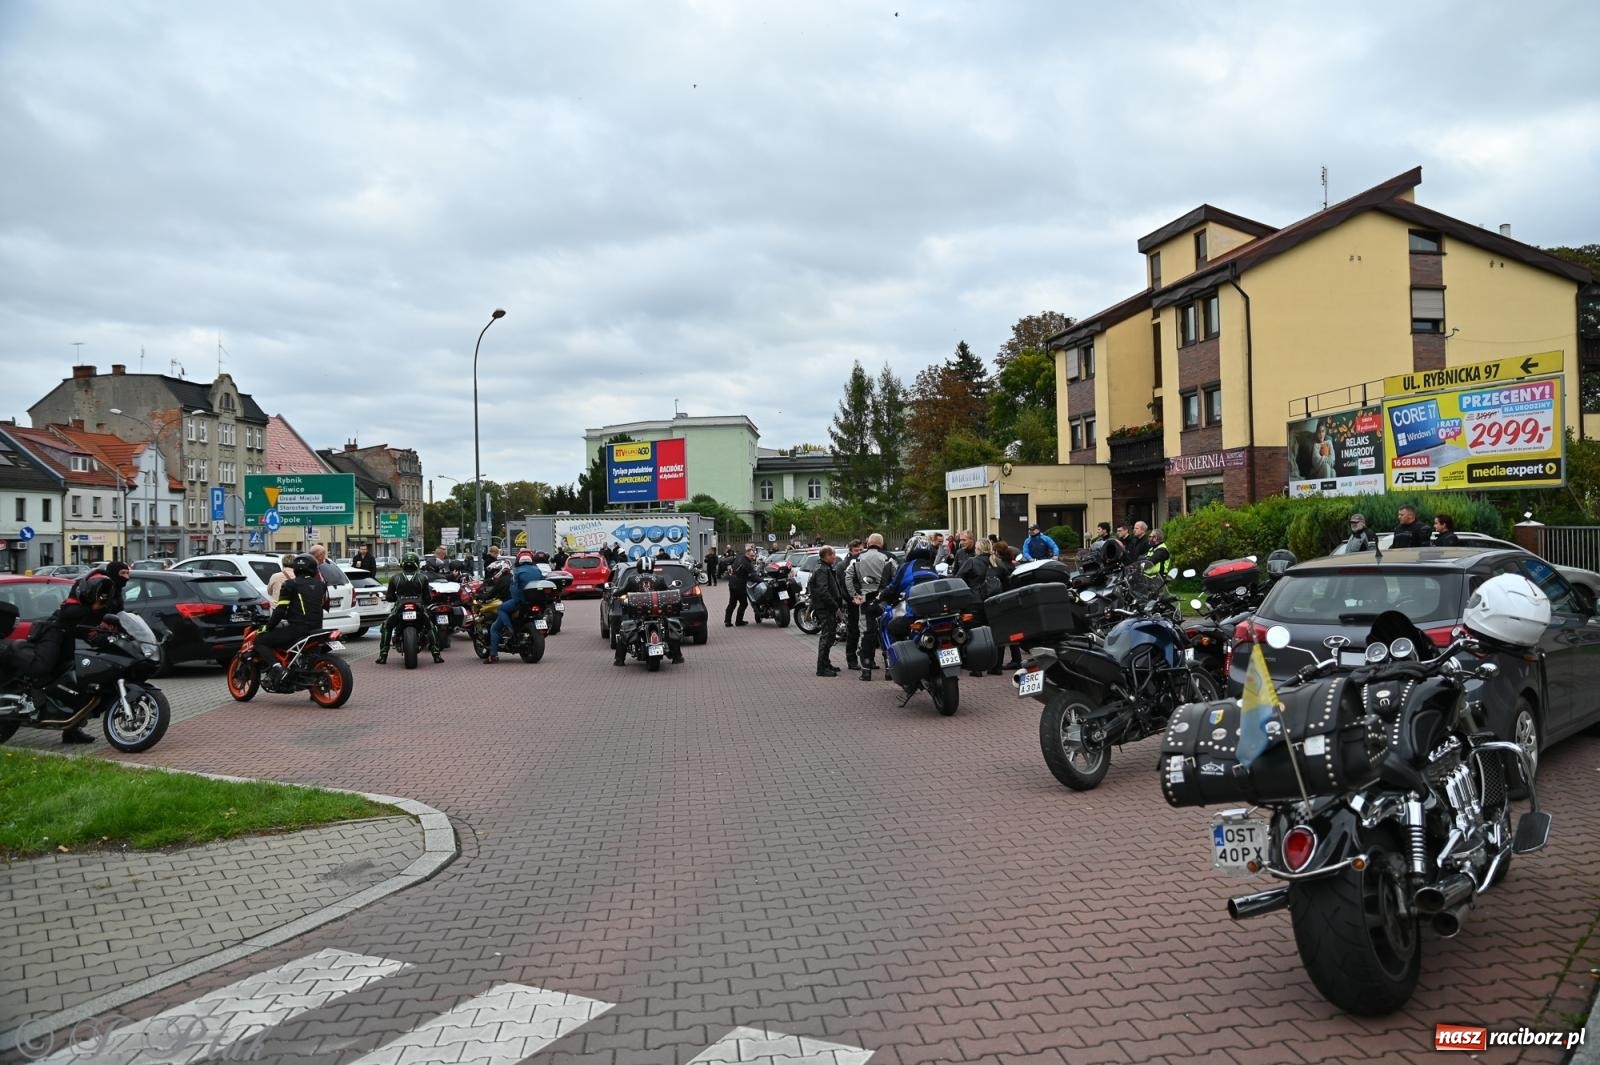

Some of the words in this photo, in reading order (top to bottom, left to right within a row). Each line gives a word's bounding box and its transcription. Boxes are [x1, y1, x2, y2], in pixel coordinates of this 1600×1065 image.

[1403, 377, 1420, 390] UL.
[1423, 366, 1481, 388] RYBNICKA
[1485, 364, 1500, 379] 97
[1462, 386, 1550, 408] PRZECENY!
[1515, 402, 1551, 411] URODZINY
[1393, 406, 1427, 427] CORE
[1440, 419, 1460, 428] RATY
[1407, 431, 1431, 442] Windows
[1439, 427, 1455, 439] 0%
[1469, 417, 1551, 448] 2999,-
[1346, 435, 1370, 447] RELAKS
[1344, 445, 1375, 458] NAGRODY
[1176, 453, 1225, 471] CUKIERNIA
[1412, 457, 1428, 465] RAM
[660, 464, 684, 473] RACIBÓRZ
[1472, 463, 1544, 477] mediaexpert
[277, 477, 302, 485] Rybnik
[1395, 471, 1436, 484] ASUS
[213, 490, 222, 511] P
[576, 531, 607, 548] BHP
[1025, 673, 1039, 683] SRC
[1225, 827, 1255, 843] OST
[1219, 847, 1264, 863] 40PX
